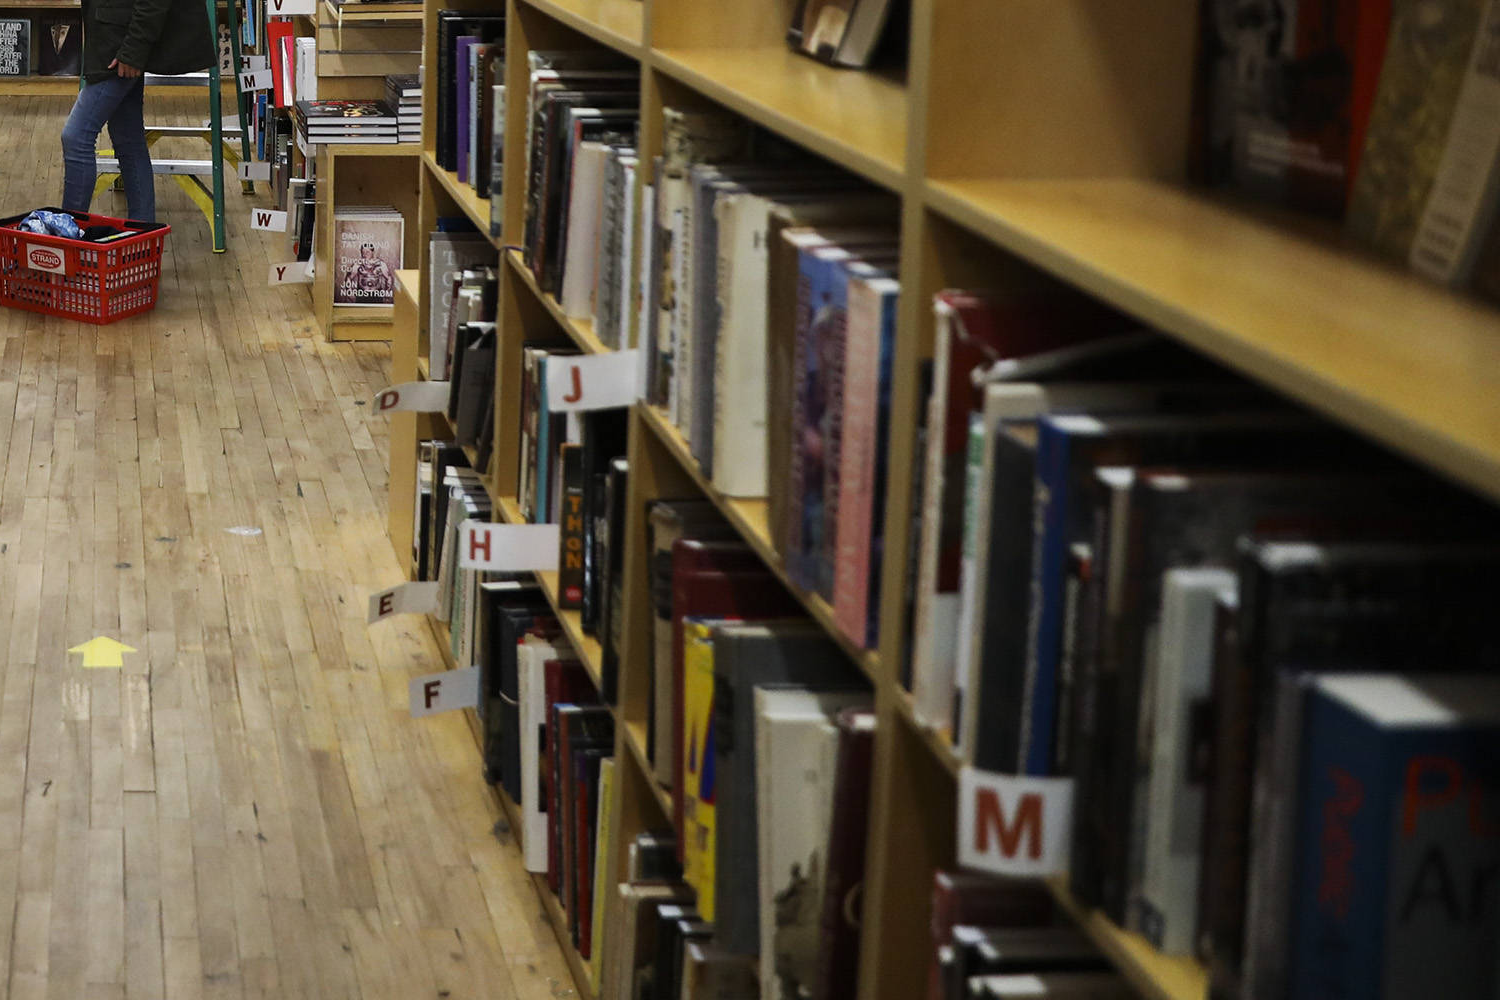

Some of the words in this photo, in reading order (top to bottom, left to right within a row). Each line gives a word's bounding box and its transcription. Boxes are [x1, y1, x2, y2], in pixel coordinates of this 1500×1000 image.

[5, 22, 22, 31] AND
[4, 59, 19, 67] THE
[241, 57, 251, 69] H
[244, 75, 255, 88] M
[257, 213, 271, 226] W
[31, 253, 60, 265] STRAND
[277, 267, 286, 280] Y
[340, 281, 358, 289] JON
[340, 289, 393, 297] NORDSTRØM
[564, 367, 582, 403] J
[380, 391, 399, 410] D
[470, 530, 490, 561] H
[379, 593, 394, 616] E
[425, 681, 440, 708] F
[975, 789, 1043, 860] M
